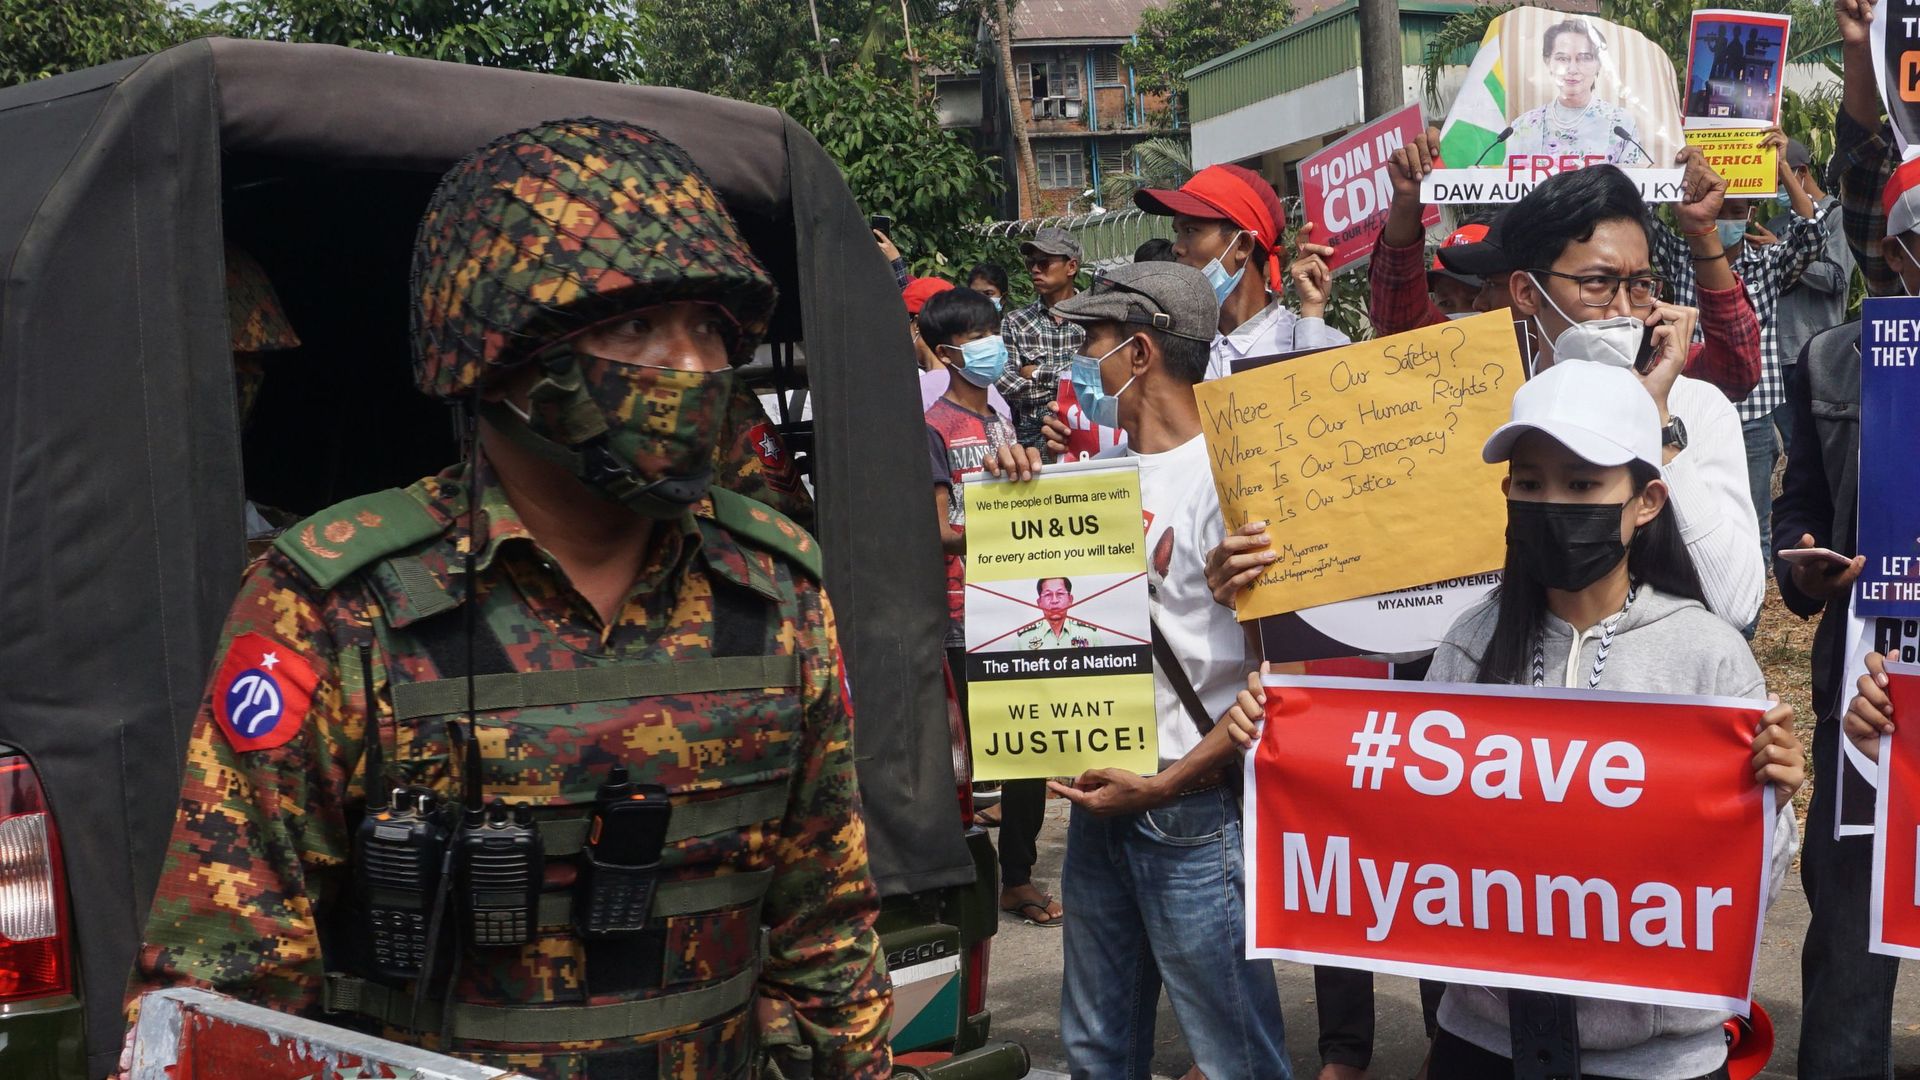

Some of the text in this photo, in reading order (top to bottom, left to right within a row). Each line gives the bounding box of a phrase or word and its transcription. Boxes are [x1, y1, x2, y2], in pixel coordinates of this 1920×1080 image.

[1375, 127, 1403, 163] IN
[1434, 183, 1484, 201] DAW
[1489, 183, 1536, 201] AUN
[1654, 182, 1685, 199] KY
[1733, 178, 1763, 188] ALLIES
[1342, 226, 1362, 240] OUR
[1872, 319, 1920, 342] THEY
[1871, 346, 1918, 367] THEY
[1204, 392, 1272, 434] Where
[1284, 373, 1311, 410] Is
[1330, 361, 1369, 392] Our
[1213, 436, 1267, 472] Where
[1273, 422, 1297, 452] Is
[1307, 414, 1347, 439] Our
[1358, 400, 1422, 425] Human
[1221, 474, 1264, 505] Where
[1270, 461, 1289, 490] Is
[1301, 455, 1334, 479] Our
[976, 488, 1130, 511] We the people of Burma are with
[1274, 496, 1297, 523] Is
[1305, 489, 1334, 511] Our
[1011, 514, 1099, 540] UN & US
[978, 542, 1135, 564] for every action you will take!
[1883, 556, 1911, 576] LET
[1436, 572, 1504, 590] MOVEMEN
[1862, 582, 1892, 600] LET
[1377, 594, 1443, 611] MYANMAR
[983, 653, 1137, 674] The Theft of a Nation!
[1008, 700, 1115, 720] WE WANT
[985, 726, 1145, 756] JUSTICE!
[1345, 709, 1646, 809] #Save
[1283, 832, 1733, 952] Myanmar
